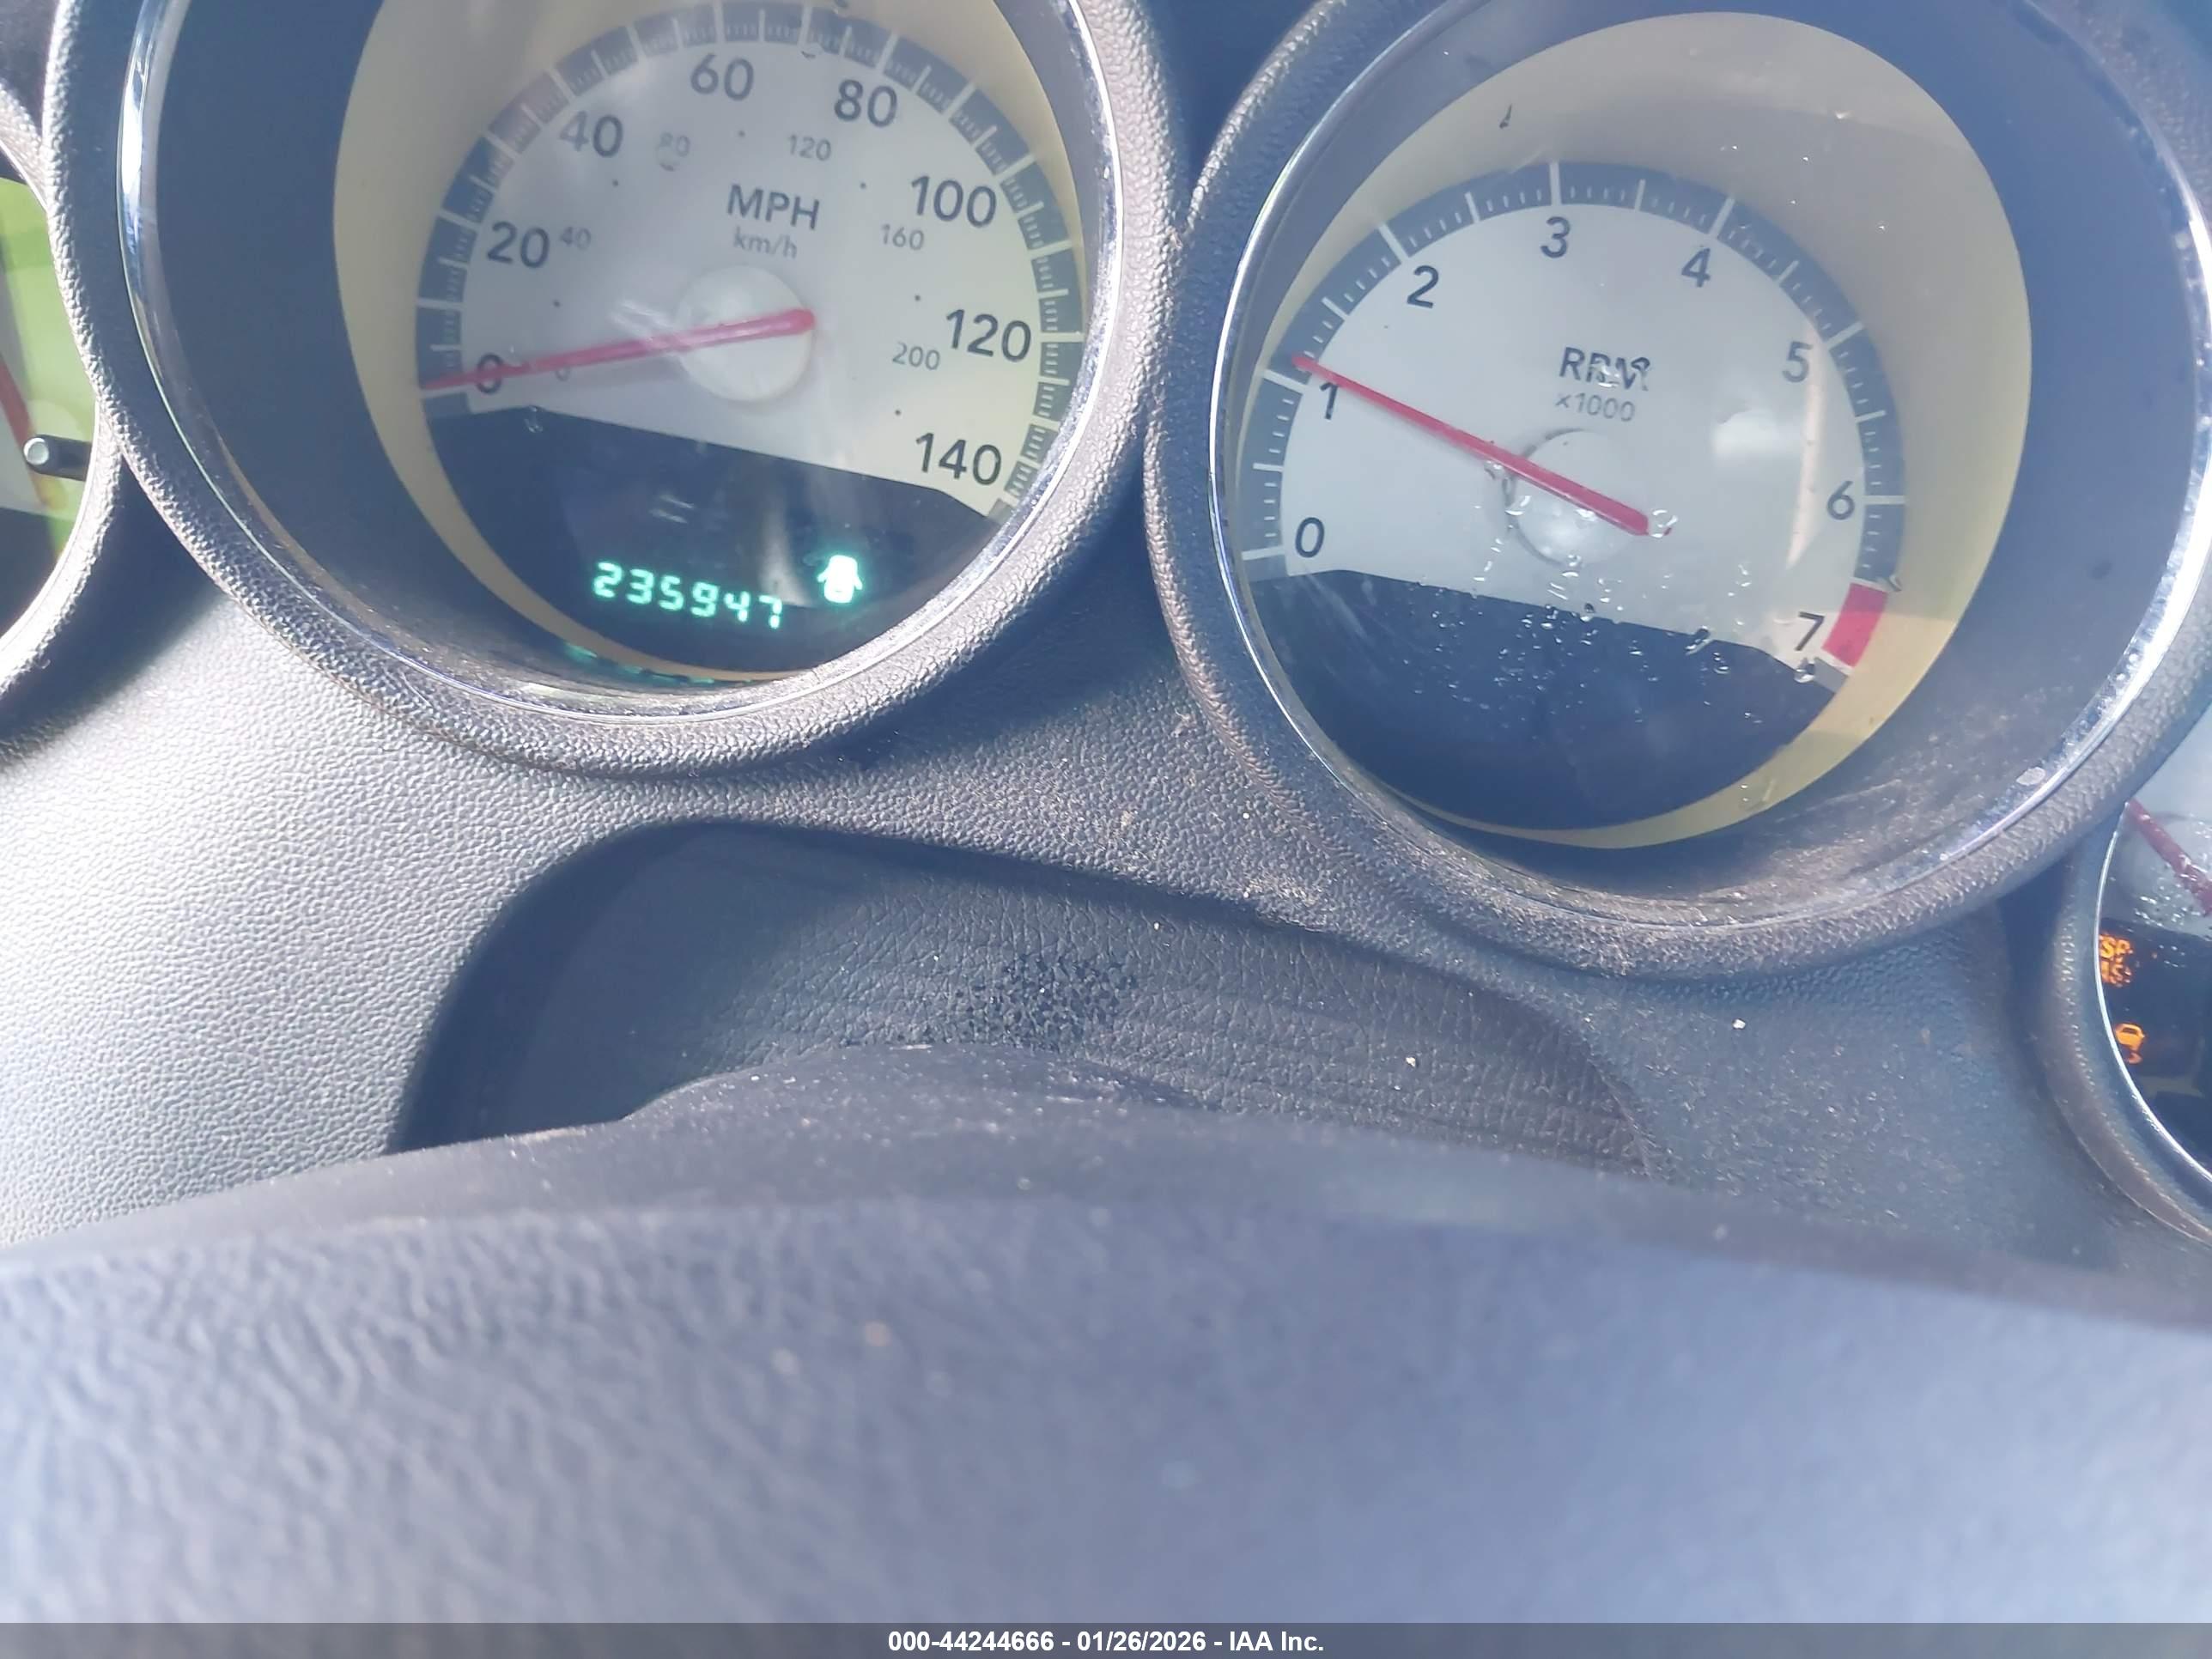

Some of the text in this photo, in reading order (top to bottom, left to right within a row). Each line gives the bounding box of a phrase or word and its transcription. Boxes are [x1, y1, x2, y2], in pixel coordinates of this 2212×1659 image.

[690, 57, 754, 100] 60
[834, 80, 897, 127] 80
[559, 112, 623, 158] 40
[787, 134, 831, 161] 120
[726, 184, 820, 230] MPH
[910, 174, 997, 228] 100
[487, 221, 550, 269] 20
[560, 225, 592, 251] 40
[732, 226, 799, 259] km/h
[881, 223, 924, 252] 160
[1541, 216, 1571, 258] 3
[1407, 264, 1440, 308] 2
[1680, 246, 1711, 288] 4
[945, 308, 1031, 362] 120
[476, 353, 502, 394] 0
[891, 342, 940, 371] 200
[1782, 340, 1812, 383] 5
[1320, 381, 1340, 420] 1
[915, 432, 1002, 486] 140
[1826, 480, 1856, 520] 6
[1294, 517, 1325, 558] 0
[592, 561, 783, 629] 235947
[1795, 611, 1826, 652] 7
